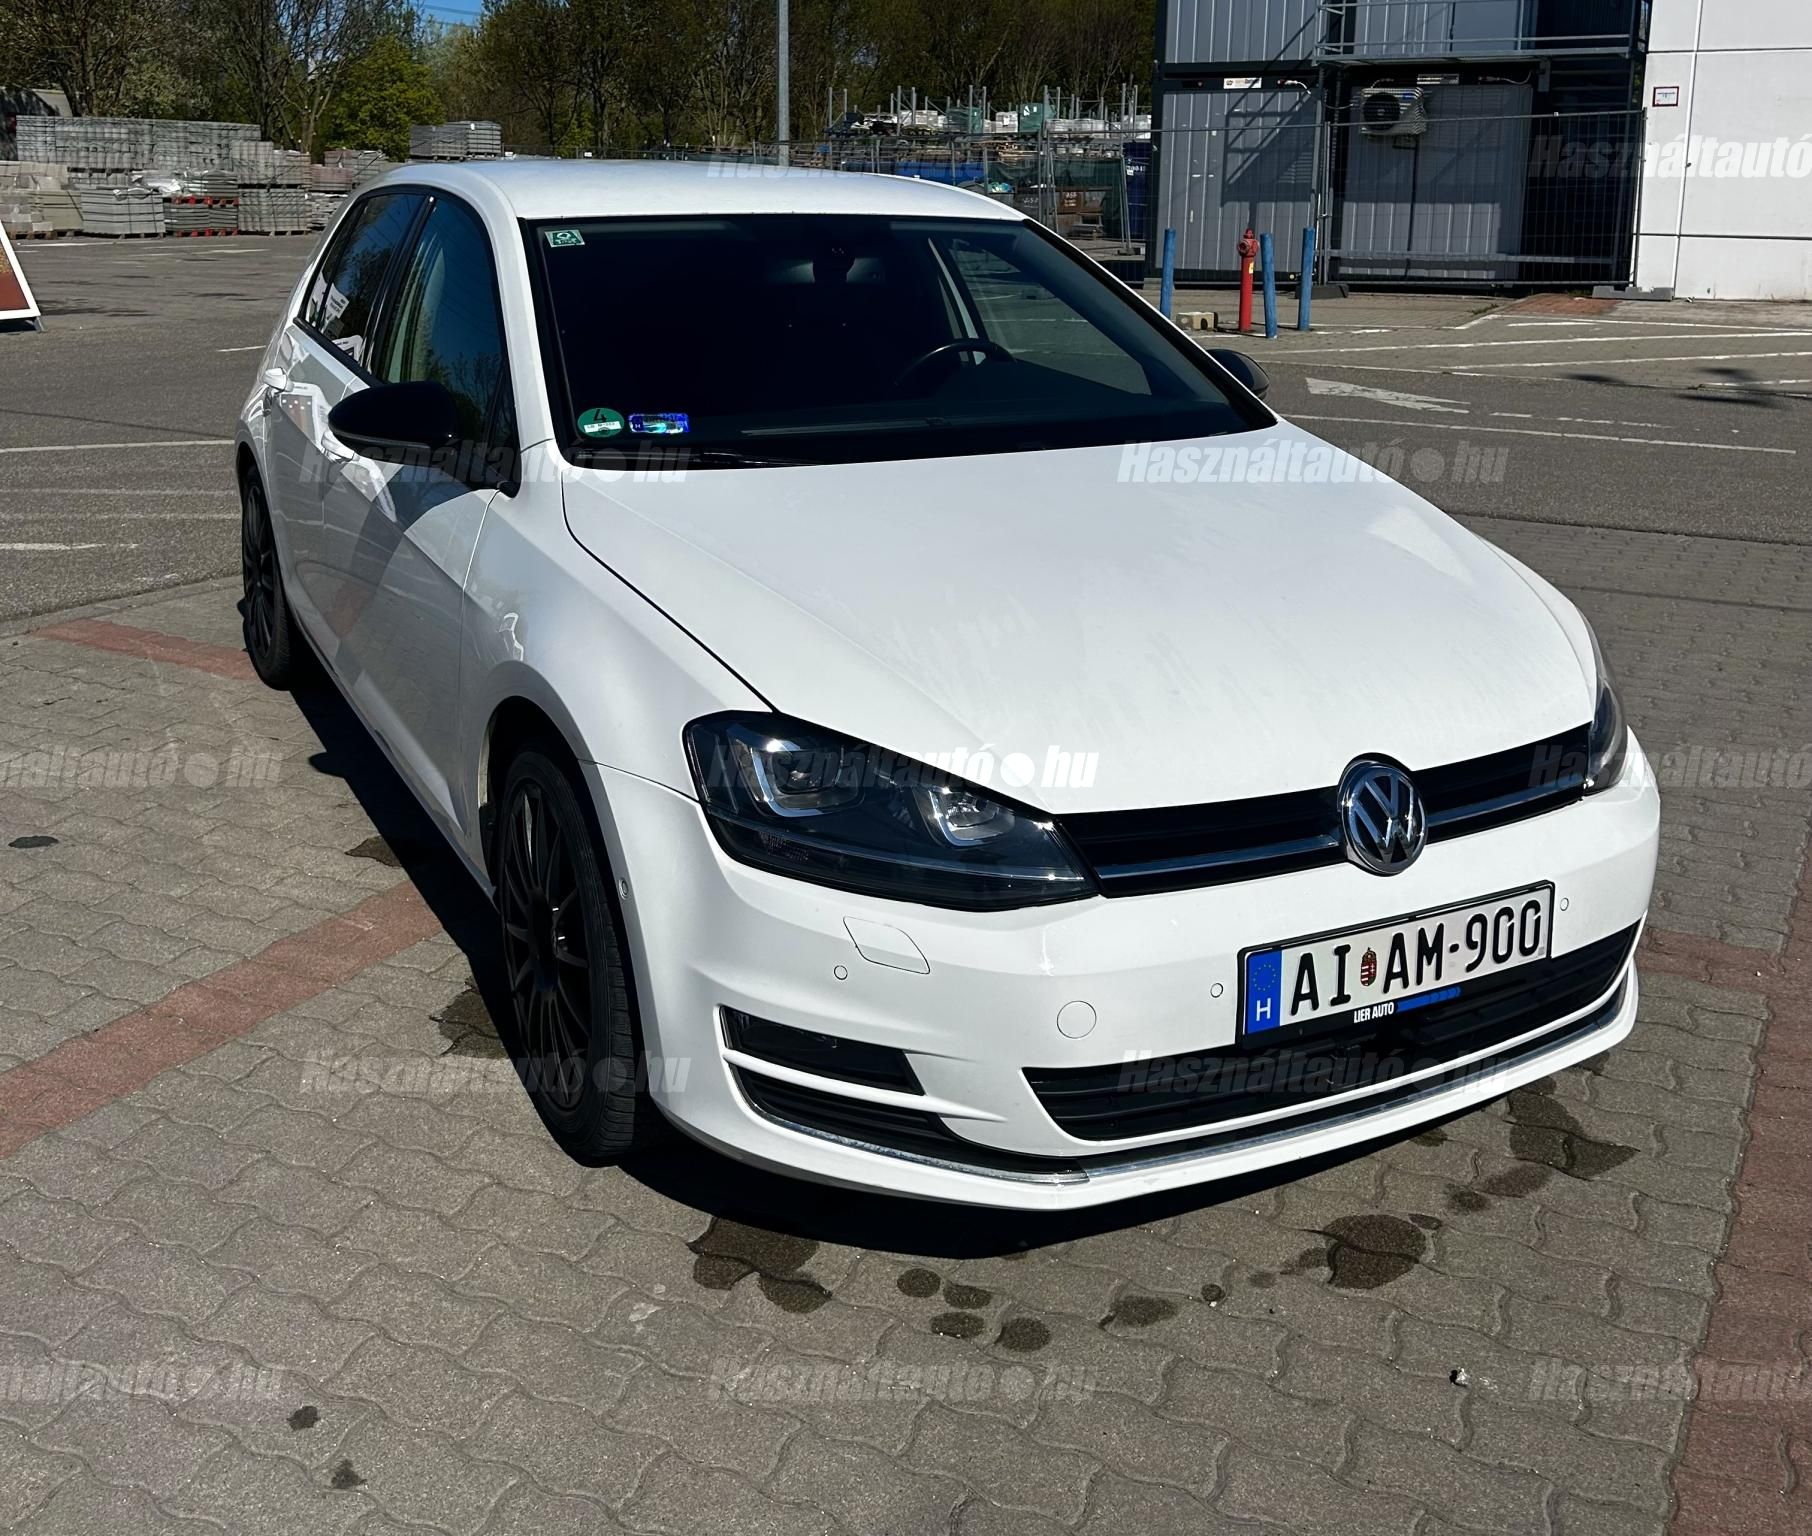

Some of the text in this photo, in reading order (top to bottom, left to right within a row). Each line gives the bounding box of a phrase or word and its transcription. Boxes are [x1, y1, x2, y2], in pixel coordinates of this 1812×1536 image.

[594, 409, 607, 423] 4
[1291, 944, 1351, 1016] AI
[1256, 998, 1272, 1022] H
[1353, 1002, 1395, 1023] LIER AUTO
